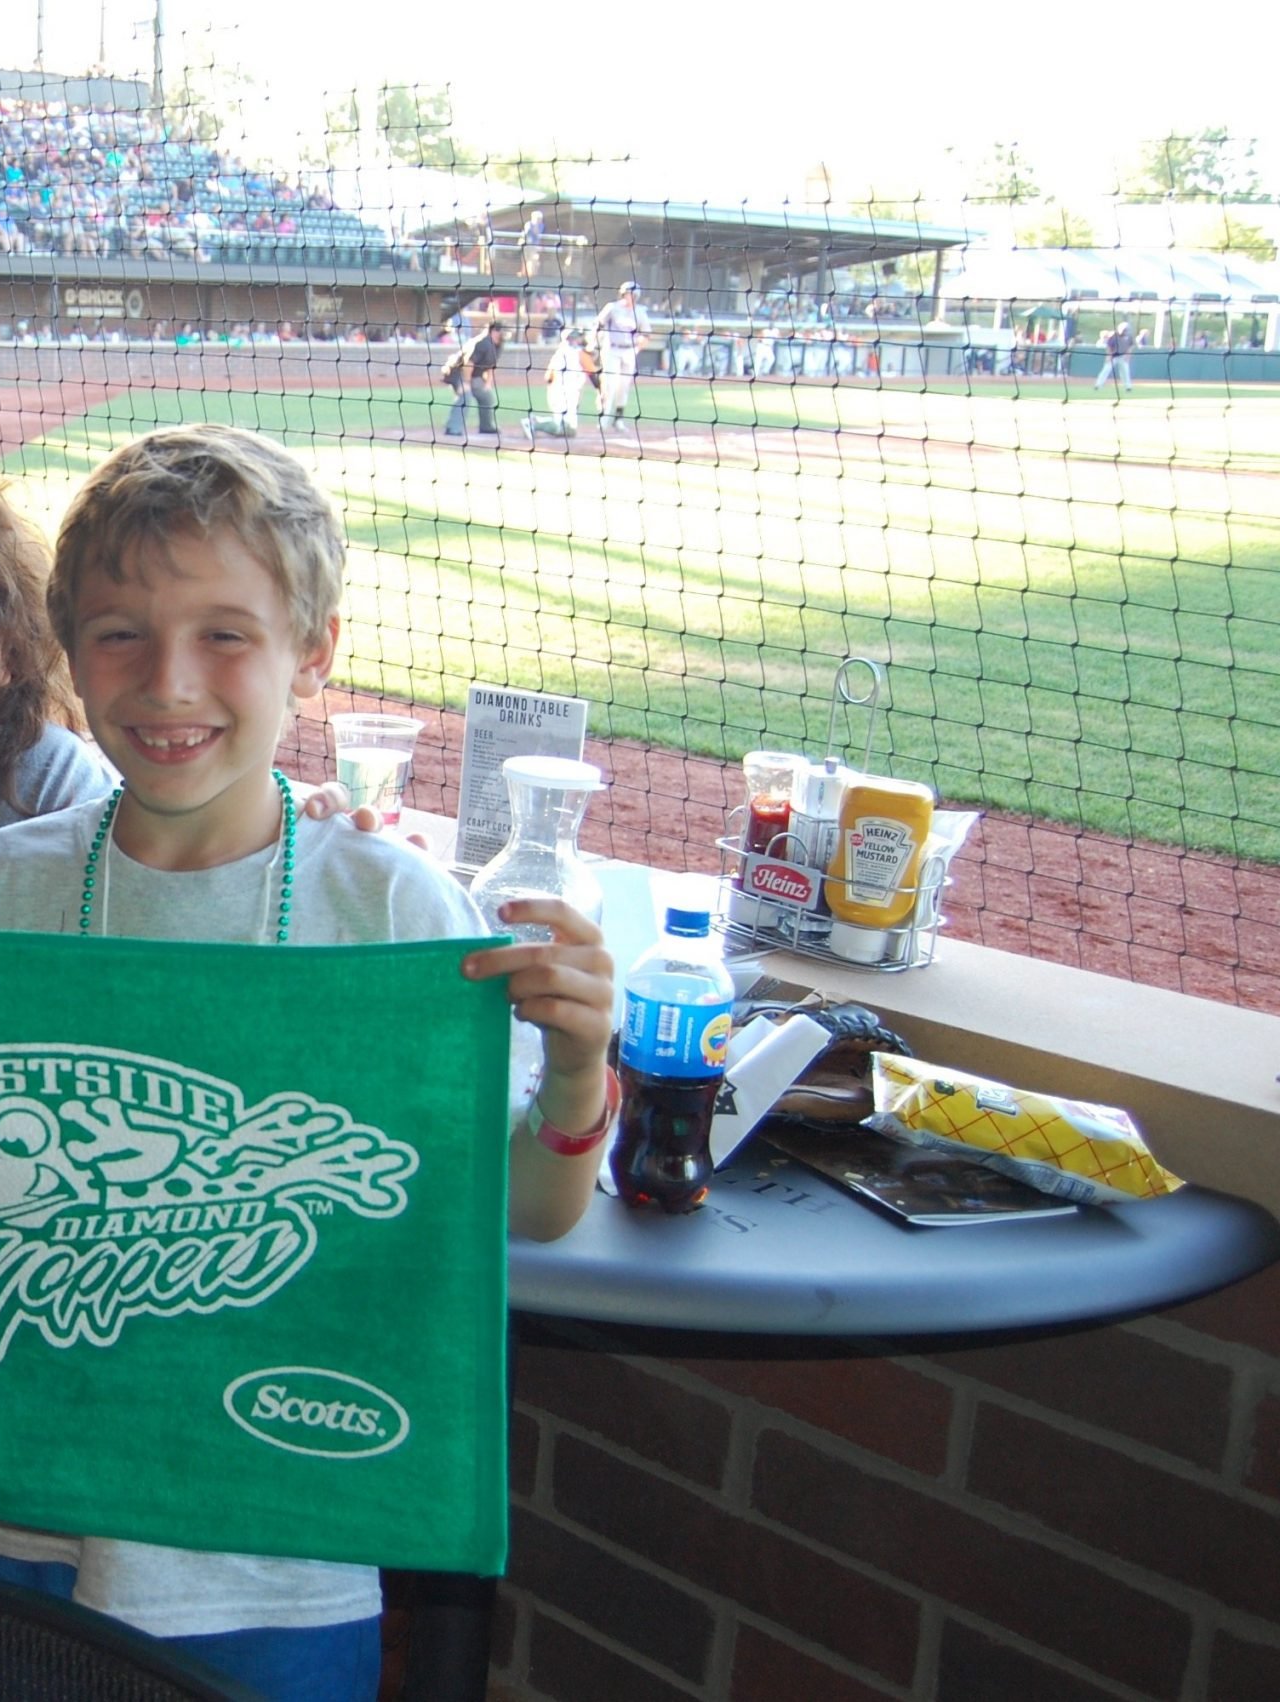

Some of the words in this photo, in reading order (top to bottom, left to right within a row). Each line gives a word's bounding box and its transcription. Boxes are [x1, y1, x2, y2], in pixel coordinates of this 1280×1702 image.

[475, 691, 528, 712] DIAMOND
[533, 699, 569, 718] TABLE
[499, 709, 542, 728] DRINKS
[473, 728, 494, 740] BEER
[466, 816, 490, 830] CRAFT
[866, 827, 898, 841] HEINZ
[864, 841, 896, 854] YELLOW
[856, 849, 899, 865] MUSTARD
[753, 868, 808, 899] Heinz
[51, 1200, 269, 1242] DIAMOND
[304, 1199, 334, 1216] TM
